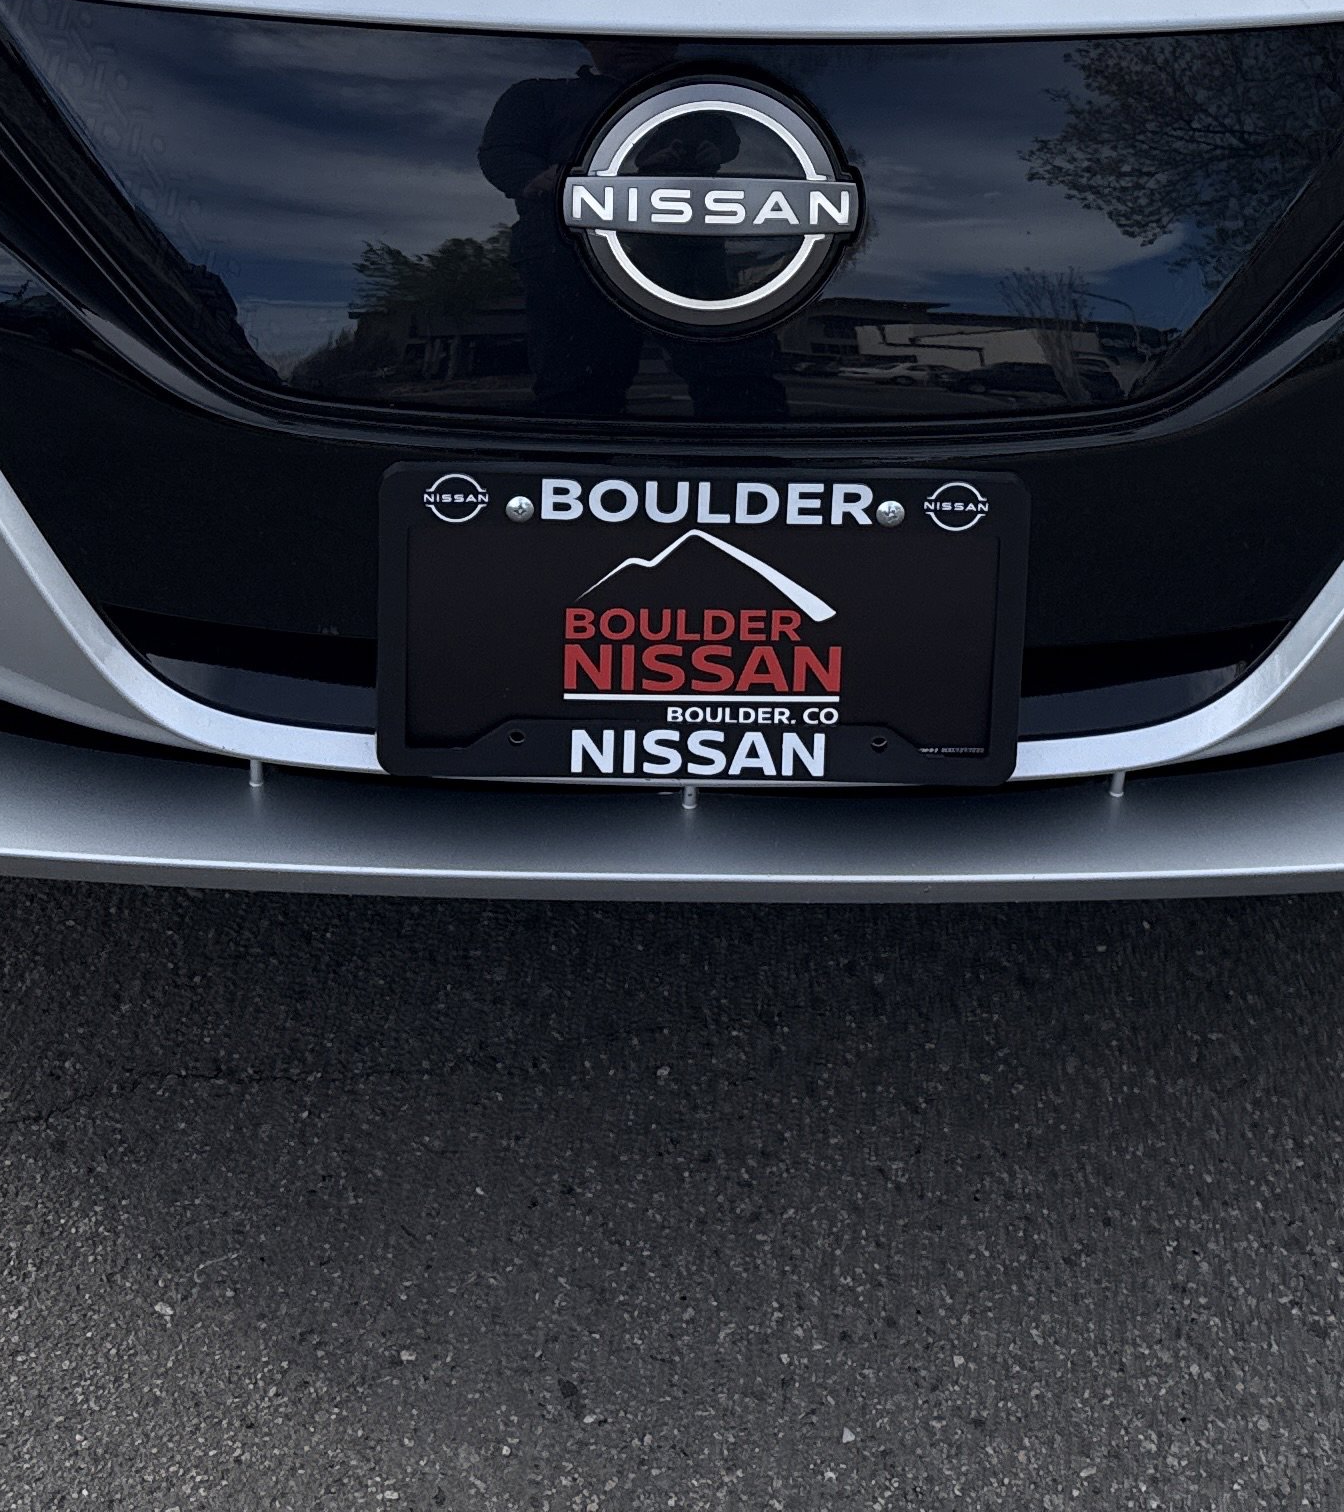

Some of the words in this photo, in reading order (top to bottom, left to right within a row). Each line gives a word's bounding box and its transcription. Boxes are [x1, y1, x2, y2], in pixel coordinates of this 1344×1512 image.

[571, 184, 851, 226] NISSAN
[423, 492, 489, 503] NISSAN
[540, 478, 874, 525] BOULDER
[923, 501, 989, 512] NISSAN
[564, 607, 803, 641] BOULDER
[563, 643, 843, 693] NISSAN
[802, 707, 839, 725] CO
[570, 729, 826, 778] NISSAN
